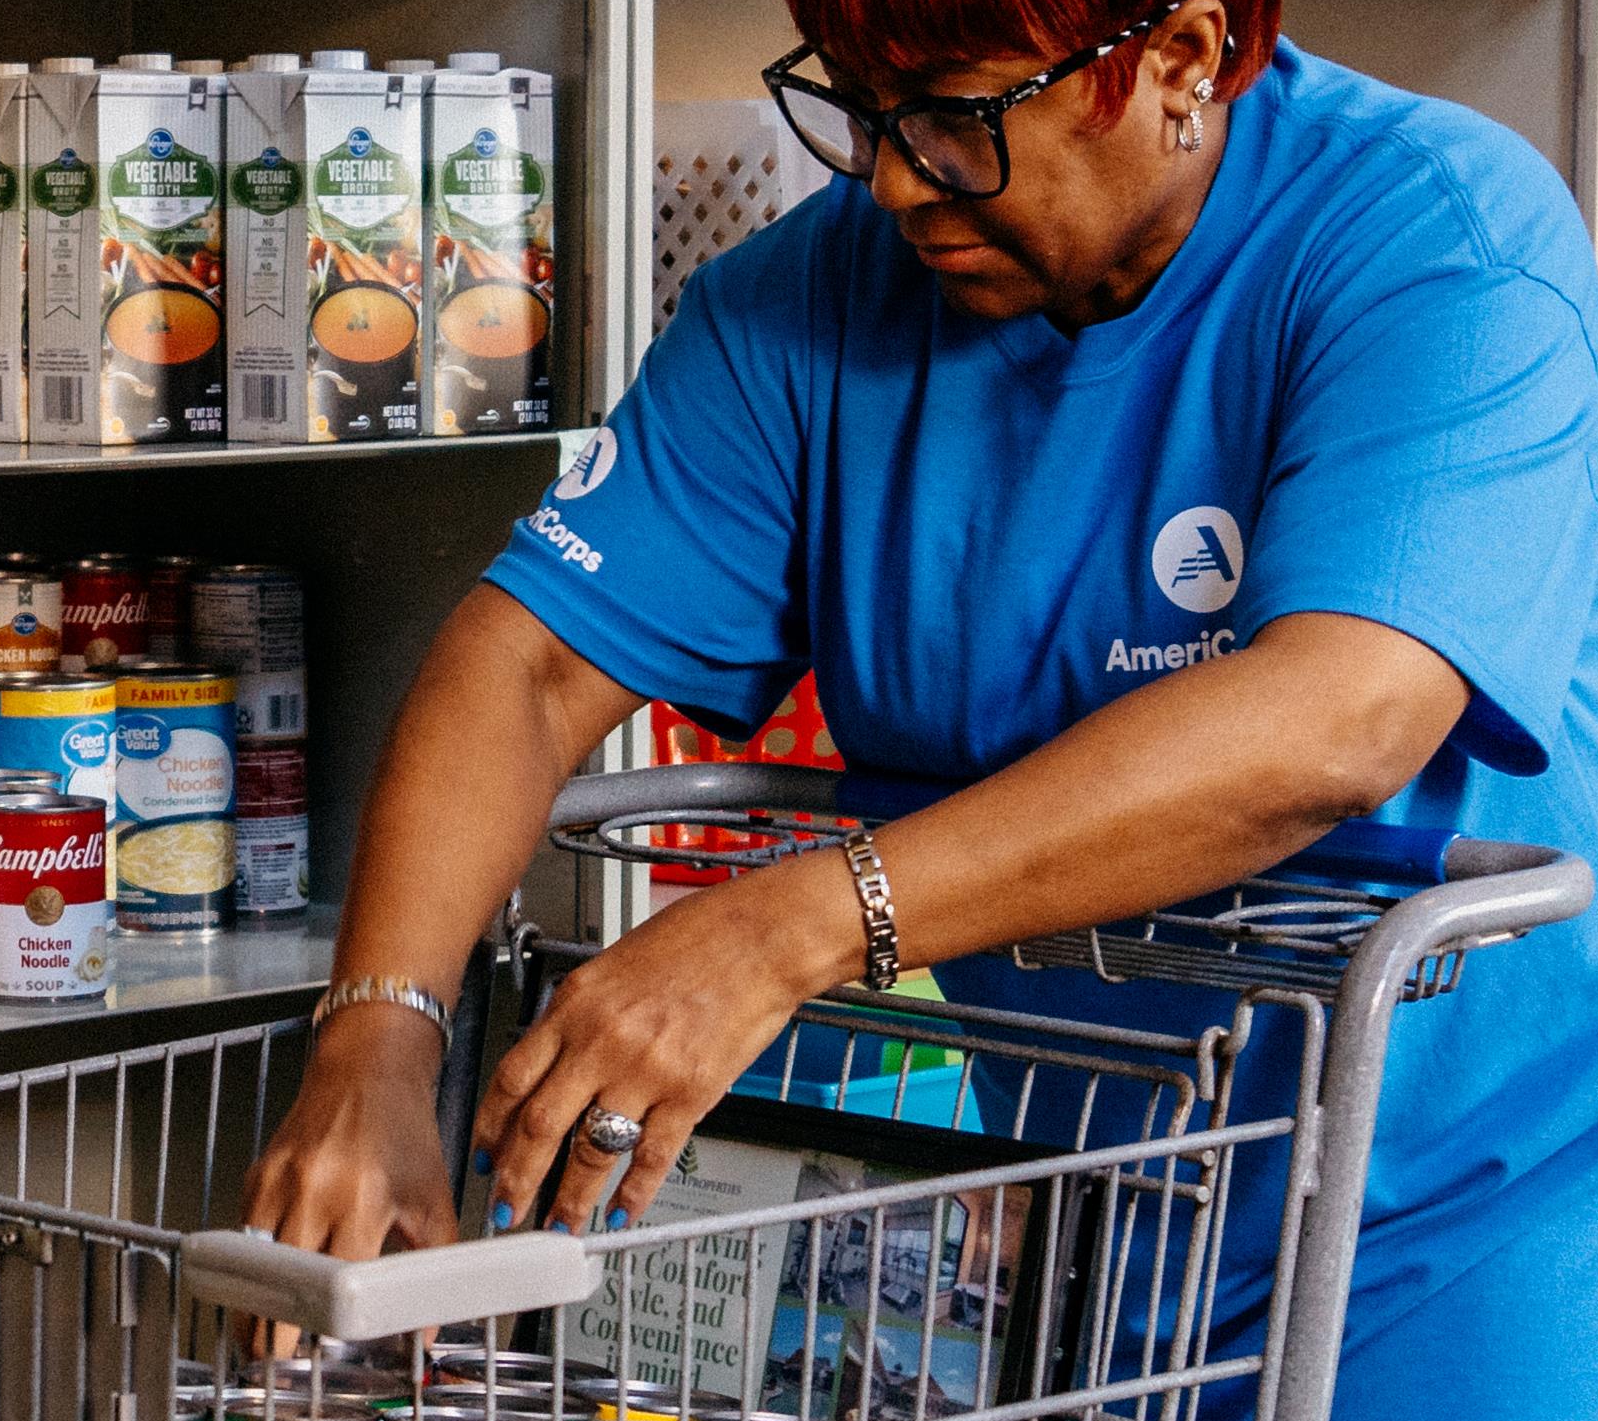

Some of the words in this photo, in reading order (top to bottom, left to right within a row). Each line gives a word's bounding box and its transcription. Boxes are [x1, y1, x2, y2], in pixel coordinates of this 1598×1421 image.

[126, 162, 196, 184] VEGETABLE
[328, 159, 393, 181] VEGETABLE
[142, 185, 180, 195] BROTH
[343, 184, 376, 194] BROTH
[131, 689, 189, 701] FAMILY
[195, 687, 220, 699] SIZE
[115, 725, 161, 741] Great
[125, 739, 160, 751] Value
[157, 756, 223, 772] Chicken
[166, 776, 224, 792] Noodle
[143, 795, 199, 808] Condensed
[202, 795, 225, 809] Soup
[18, 937, 72, 952] Chicken
[21, 955, 69, 969] Noodle
[25, 981, 64, 991] SOUP
